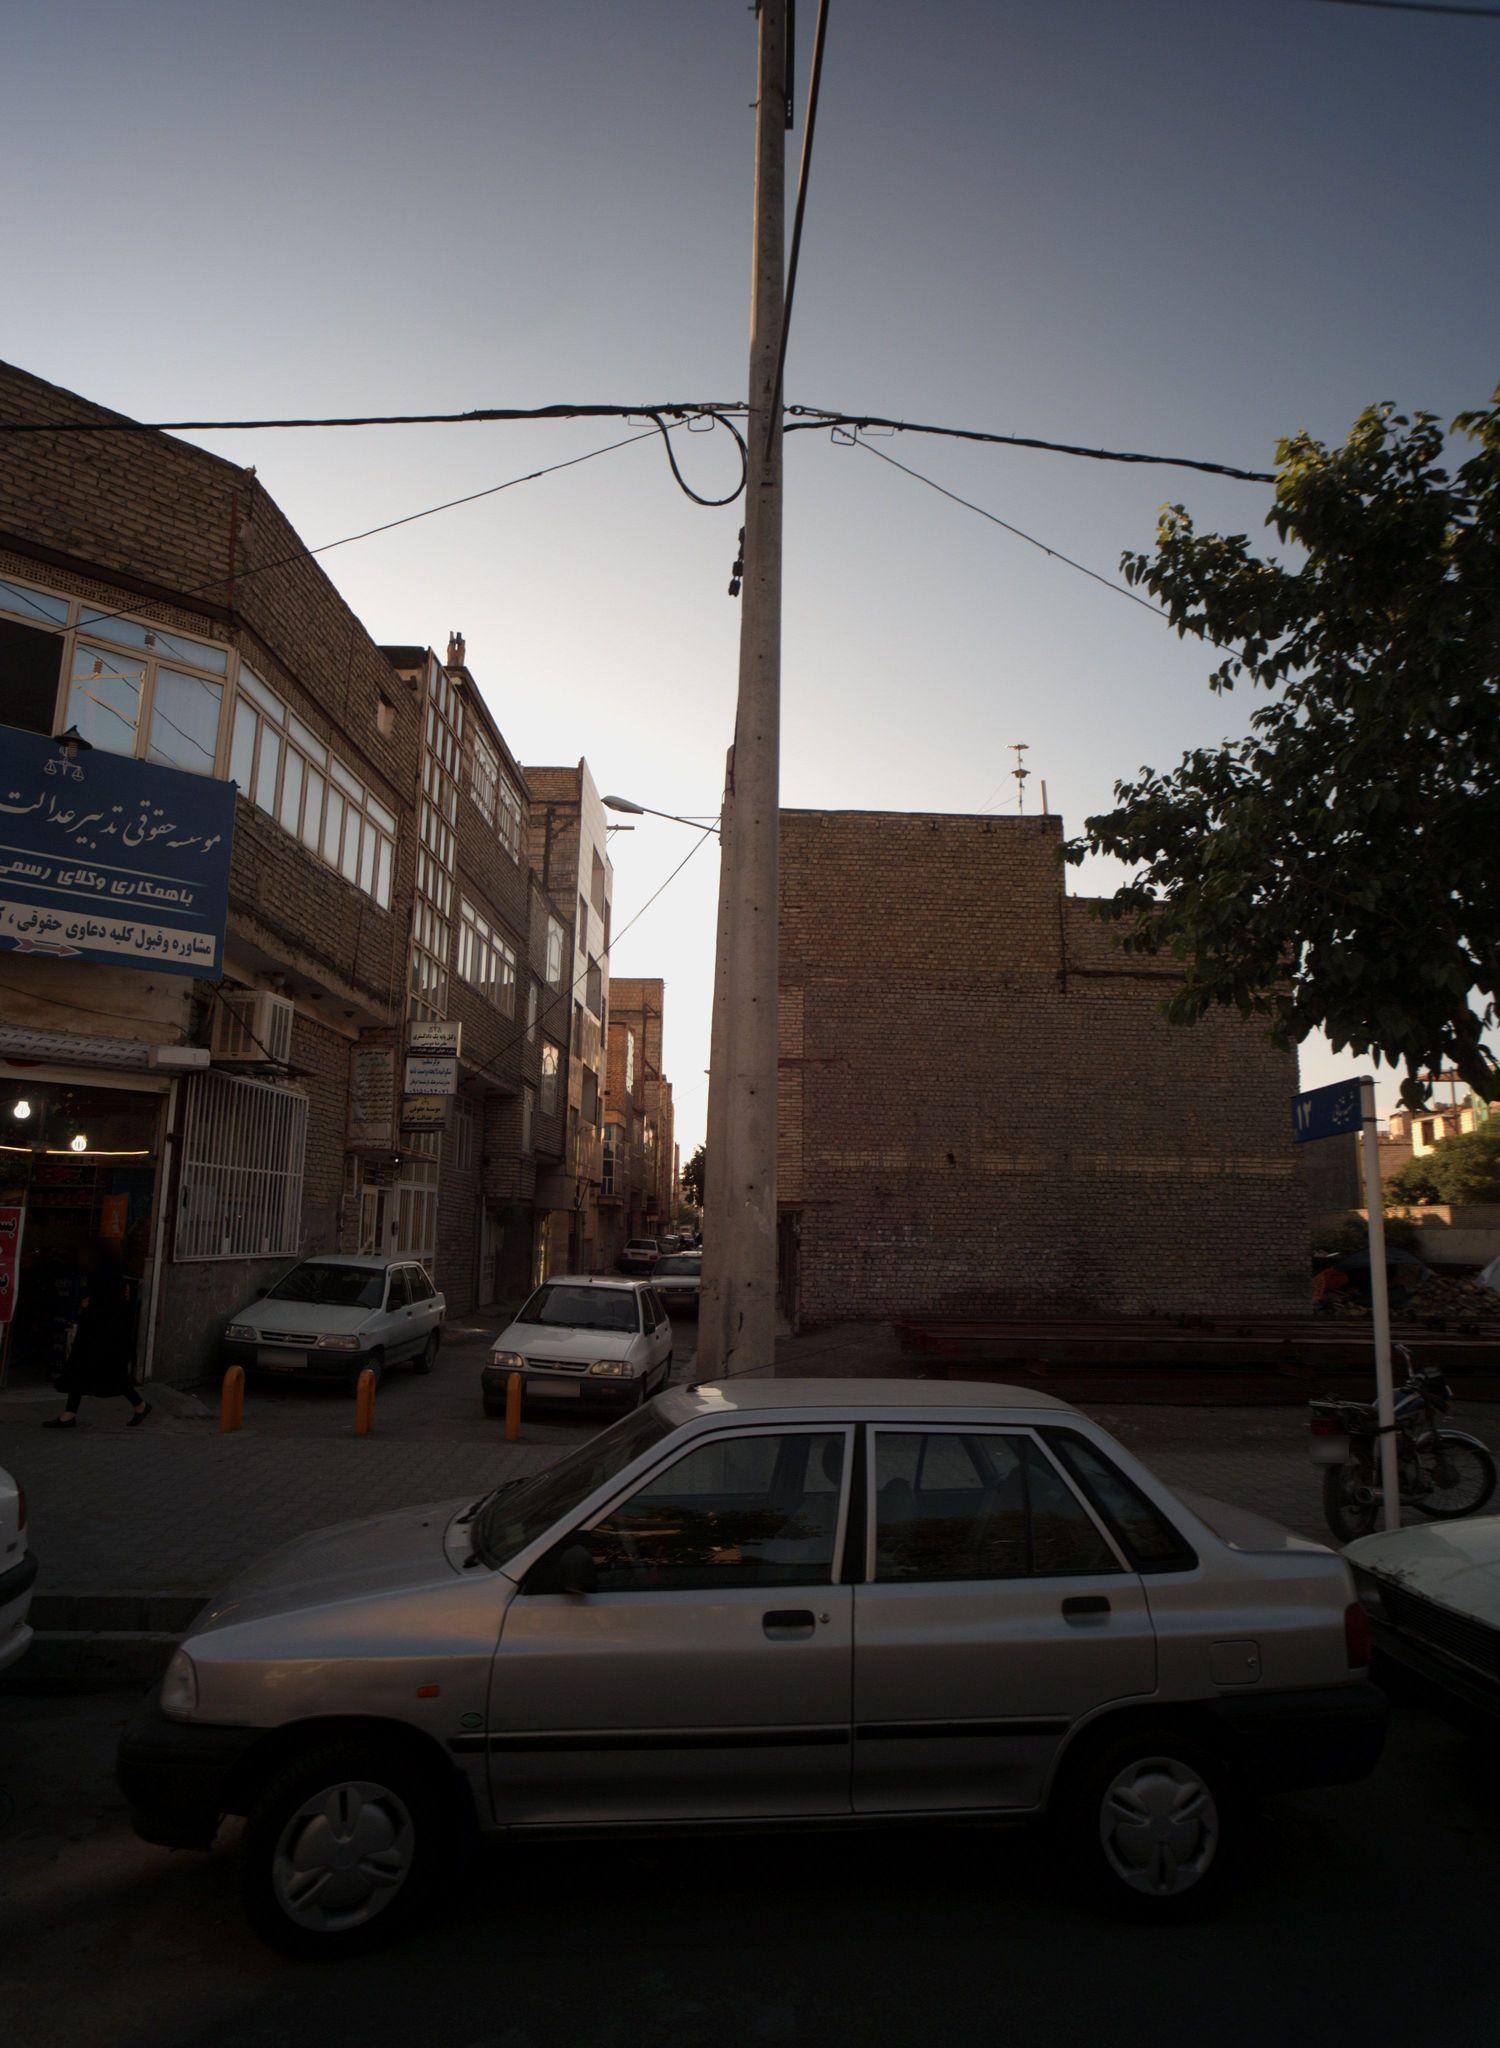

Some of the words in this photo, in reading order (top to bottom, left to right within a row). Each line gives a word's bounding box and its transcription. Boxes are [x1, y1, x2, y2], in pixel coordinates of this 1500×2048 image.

[0, 791, 75, 824] عدالت
[65, 805, 124, 849] تدبیر
[122, 799, 178, 847] حقوقی
[166, 833, 221, 853] موسسه
[57, 869, 106, 890] وکلای
[65, 920, 107, 940] دعاوی
[109, 926, 135, 945] کلیه
[172, 937, 211, 956] مشاوره
